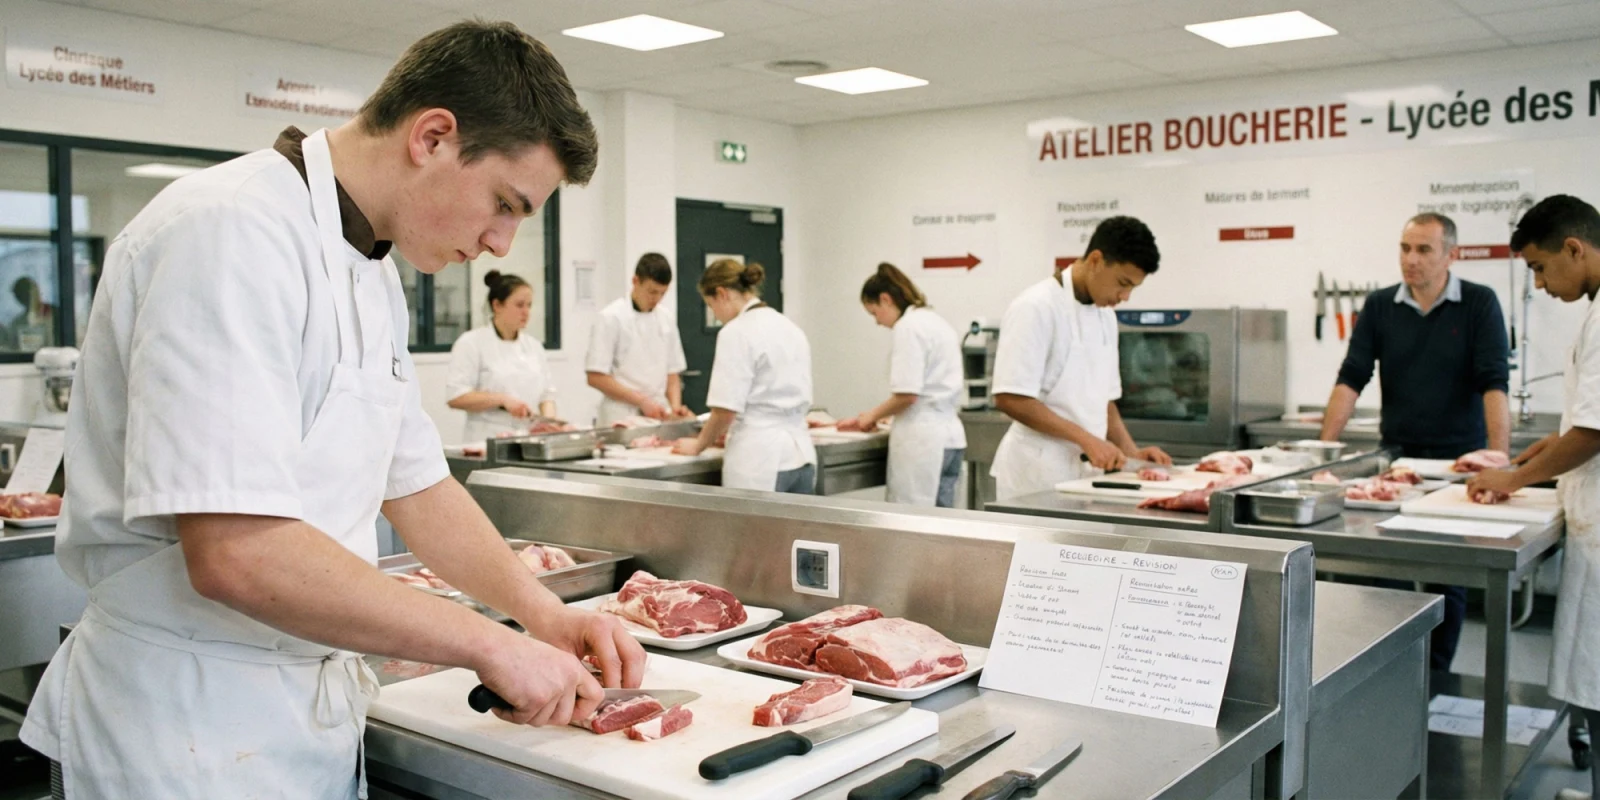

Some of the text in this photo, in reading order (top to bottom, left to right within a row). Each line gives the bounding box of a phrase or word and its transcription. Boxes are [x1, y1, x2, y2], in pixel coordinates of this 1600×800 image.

[69, 70, 96, 87] des
[100, 73, 156, 94] Métiers
[1039, 121, 1153, 161] ATELIER
[1163, 102, 1347, 152] BOUCHERIE
[1387, 90, 1491, 140] Lycée
[1504, 86, 1573, 124] des
[1133, 557, 1178, 571] REVISION
